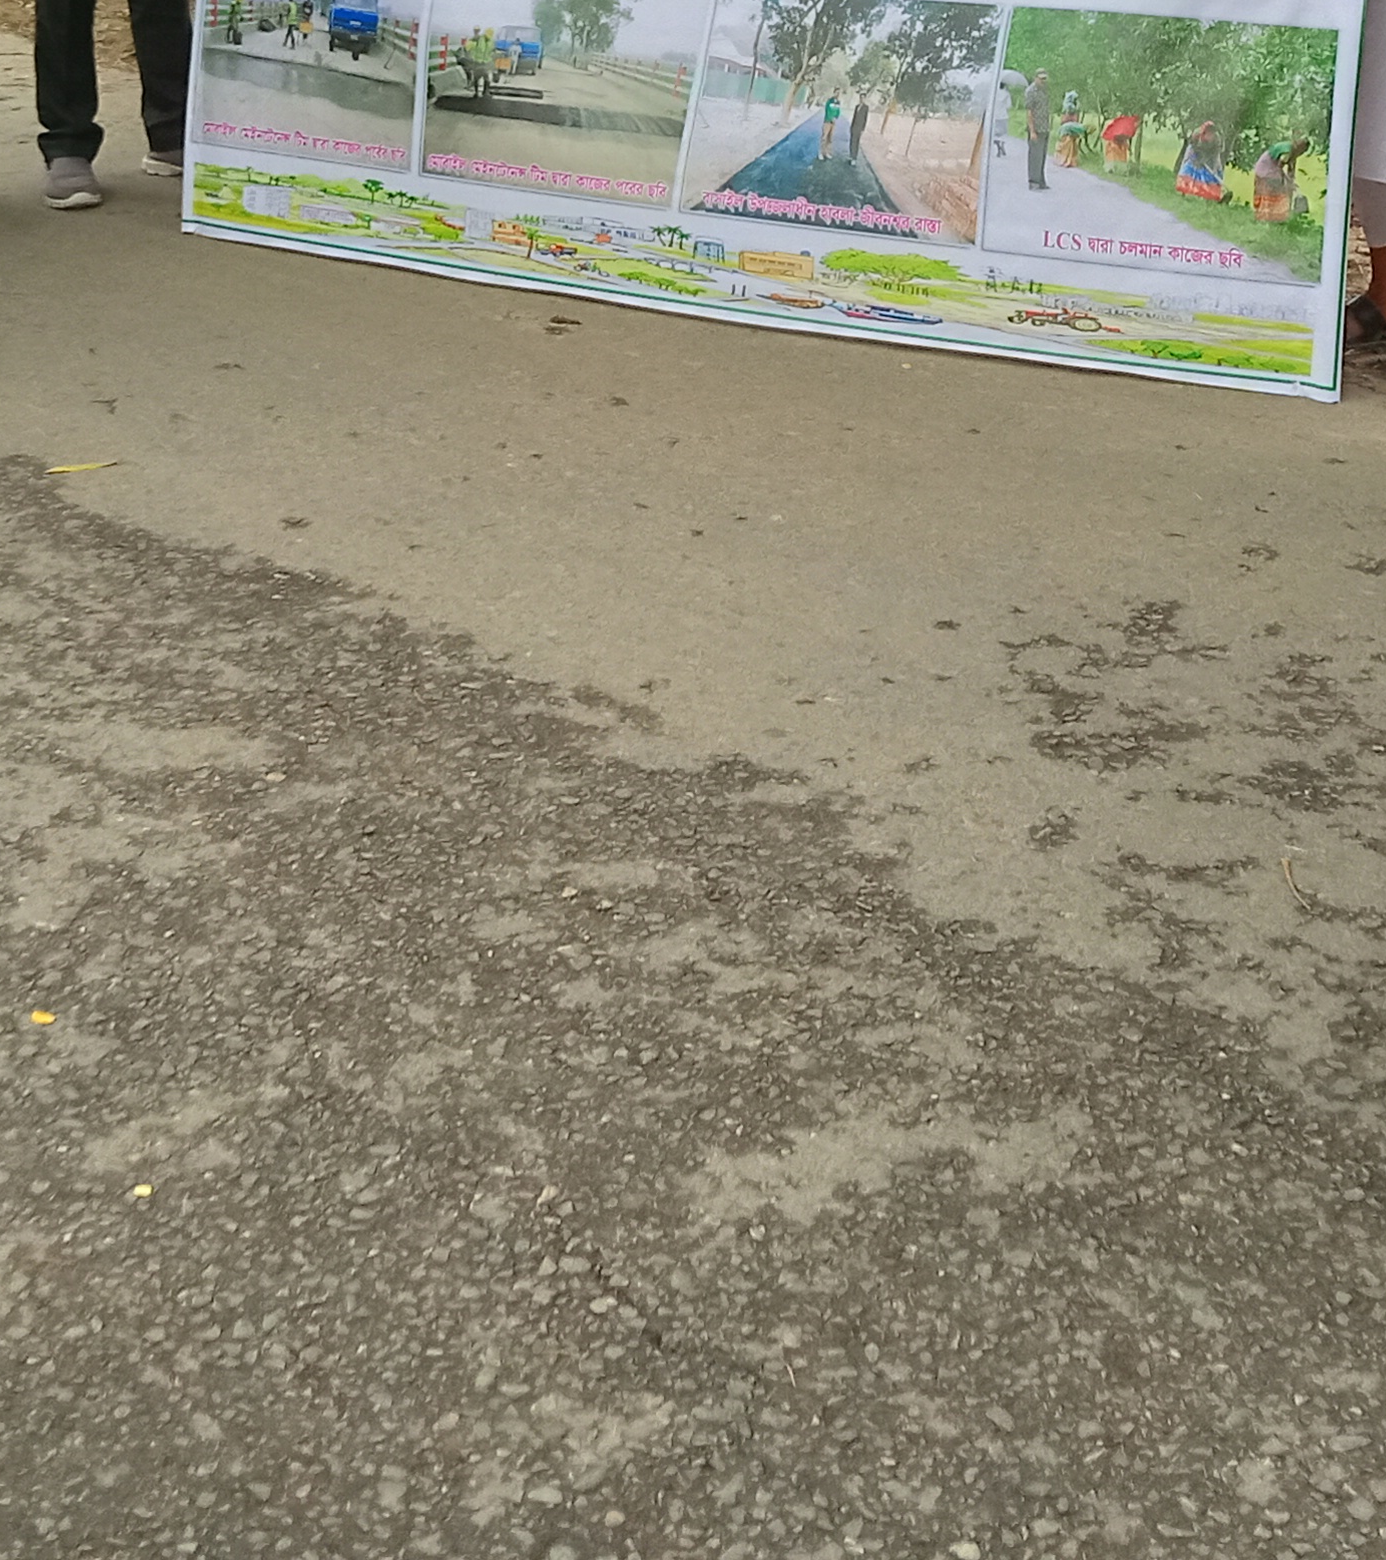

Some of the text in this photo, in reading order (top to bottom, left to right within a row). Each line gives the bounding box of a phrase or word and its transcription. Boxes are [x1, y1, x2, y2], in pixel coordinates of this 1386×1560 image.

[576, 174, 611, 192] কাজের
[648, 180, 667, 199] ছবি
[703, 190, 744, 213] বাসাইল
[914, 217, 942, 235] রাস্তা
[1042, 230, 1244, 268] LCS দ্বারা চলমান কাজের ছবি
